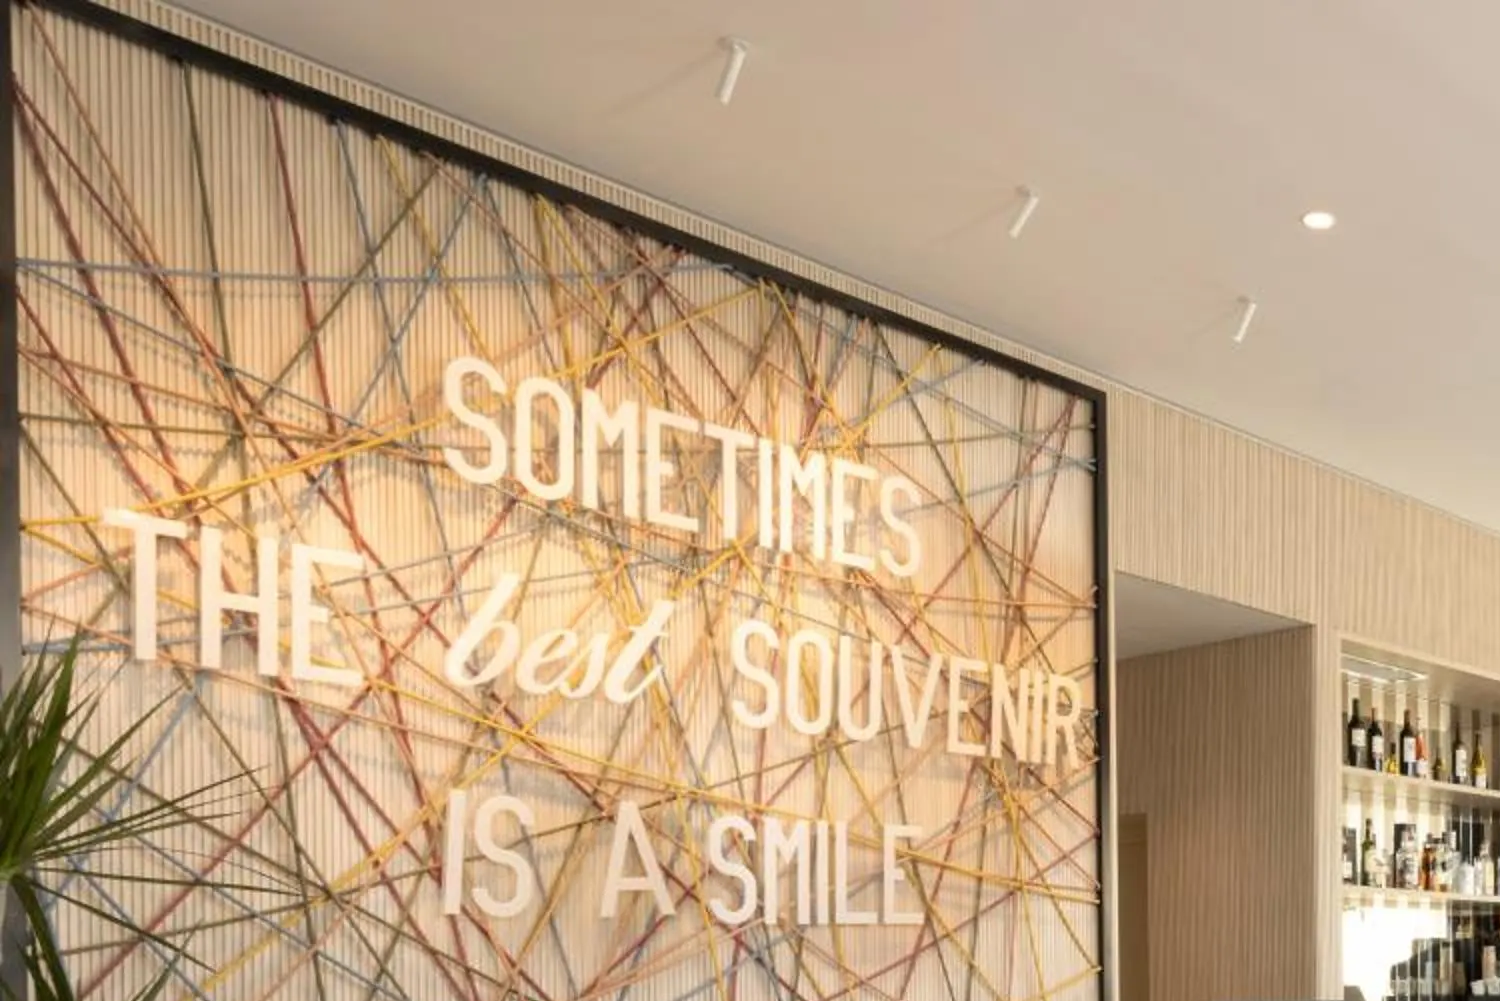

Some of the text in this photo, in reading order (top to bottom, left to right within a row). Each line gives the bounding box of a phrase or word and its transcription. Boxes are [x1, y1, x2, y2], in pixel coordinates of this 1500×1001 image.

[444, 356, 922, 577] SOMETIMES
[102, 508, 1083, 770] THE best SOUVENIR
[442, 788, 924, 926] IS A SMILE
